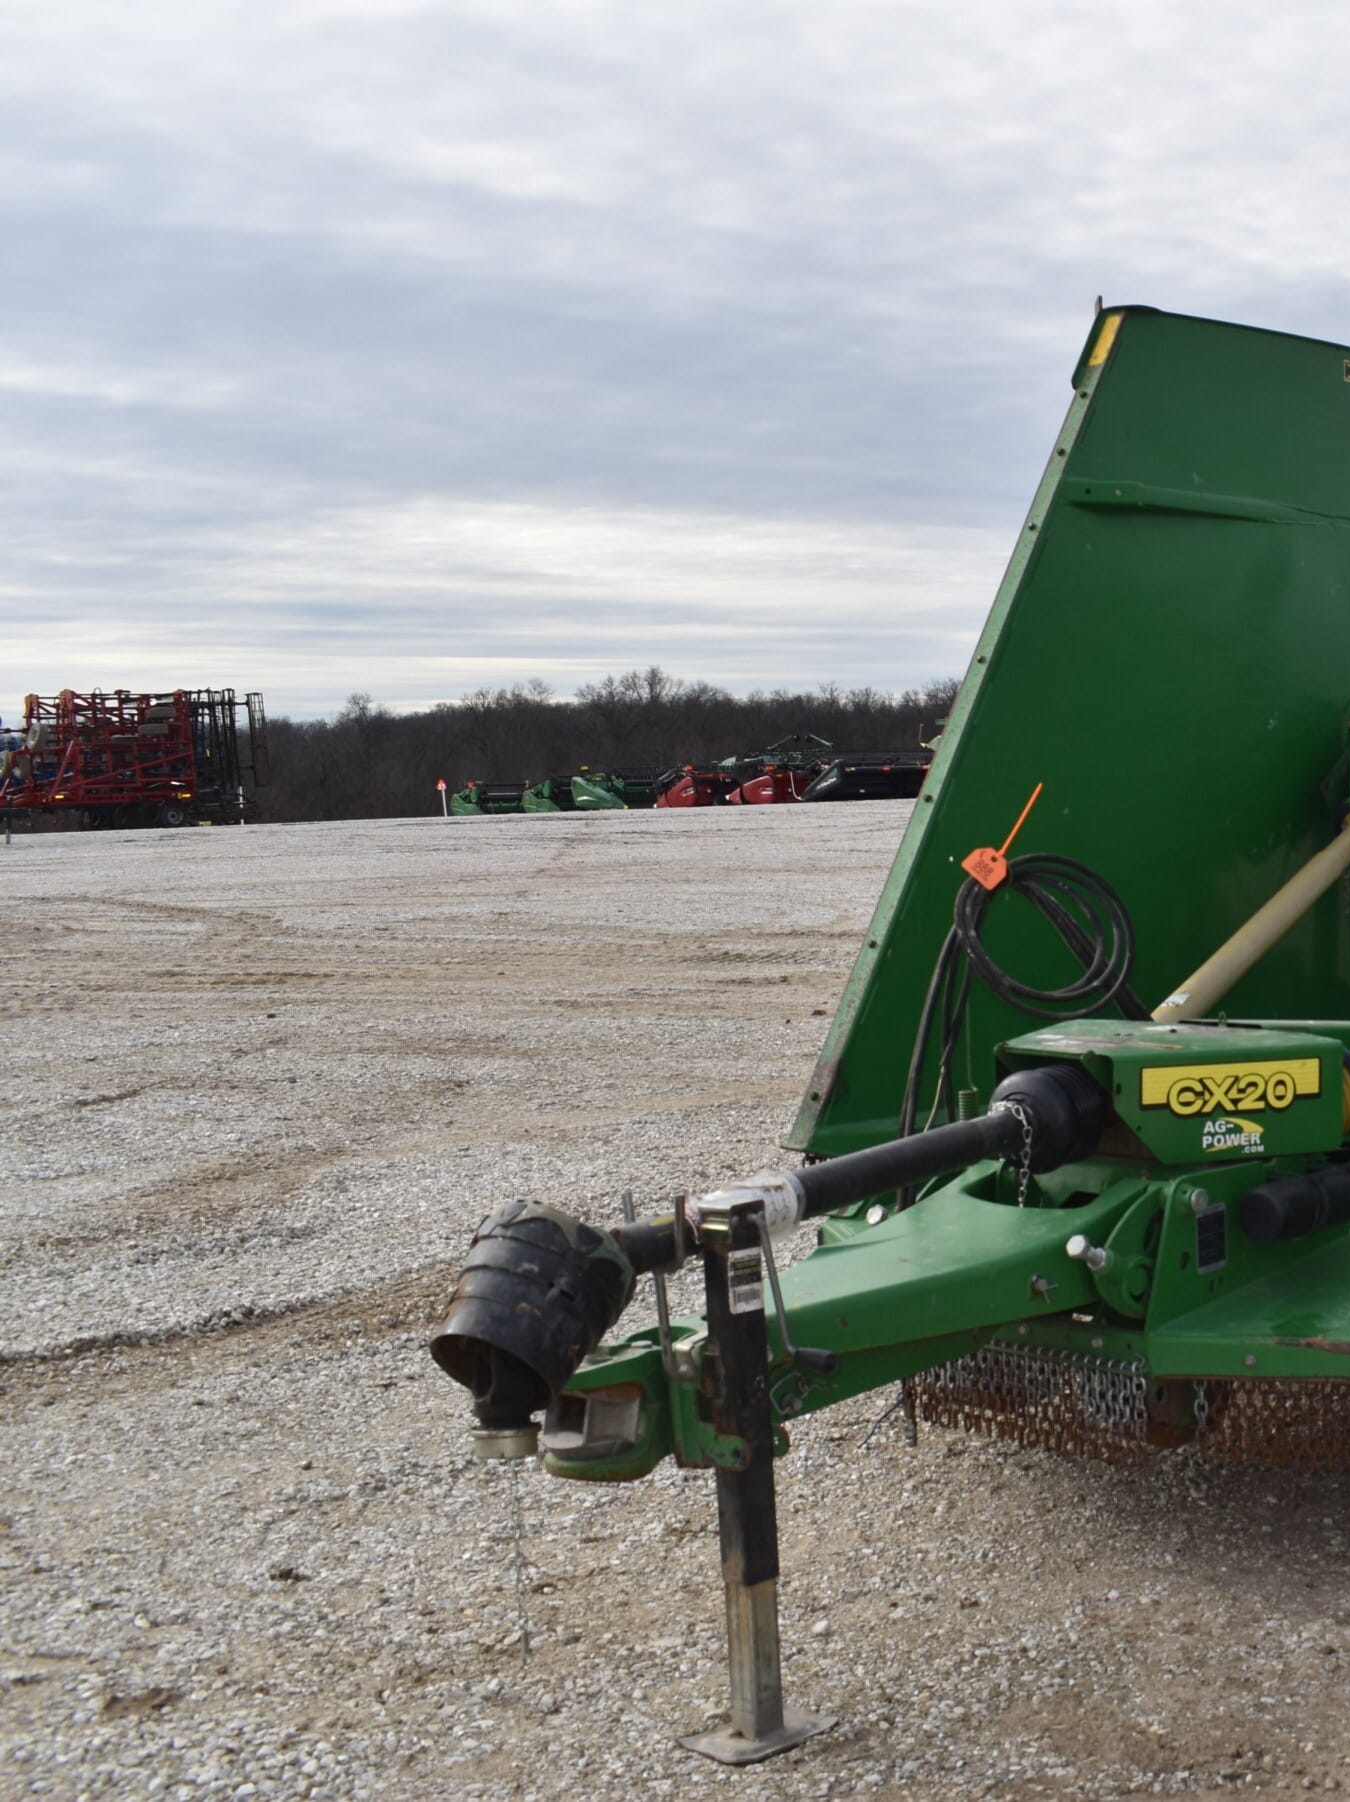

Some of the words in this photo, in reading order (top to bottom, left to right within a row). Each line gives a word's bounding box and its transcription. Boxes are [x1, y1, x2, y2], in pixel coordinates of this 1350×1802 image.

[1168, 1072, 1296, 1116] CX20
[1202, 1133, 1261, 1149] POWER
[1241, 1144, 1265, 1153] .COM
